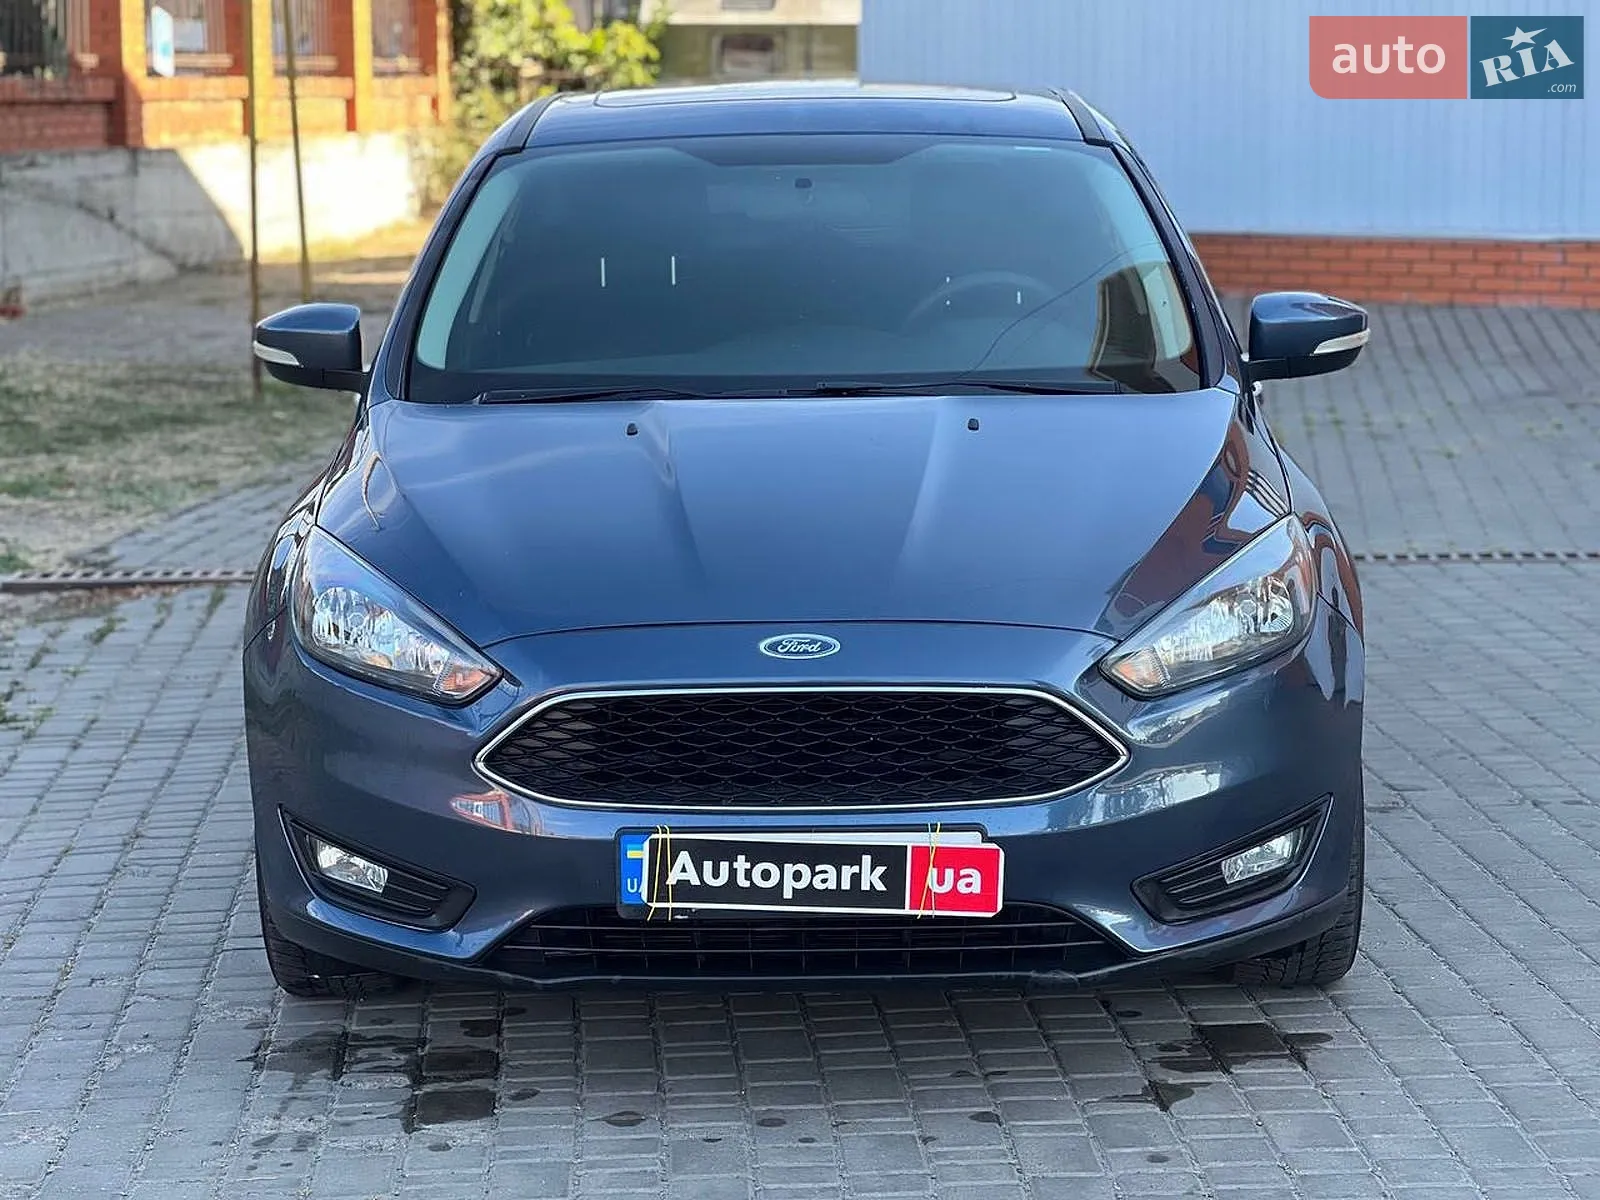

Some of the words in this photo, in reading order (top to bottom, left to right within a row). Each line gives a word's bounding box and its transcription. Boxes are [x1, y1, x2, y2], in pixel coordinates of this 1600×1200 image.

[777, 639, 821, 653] Ford
[666, 850, 888, 899] Autopark
[928, 867, 981, 894] ua
